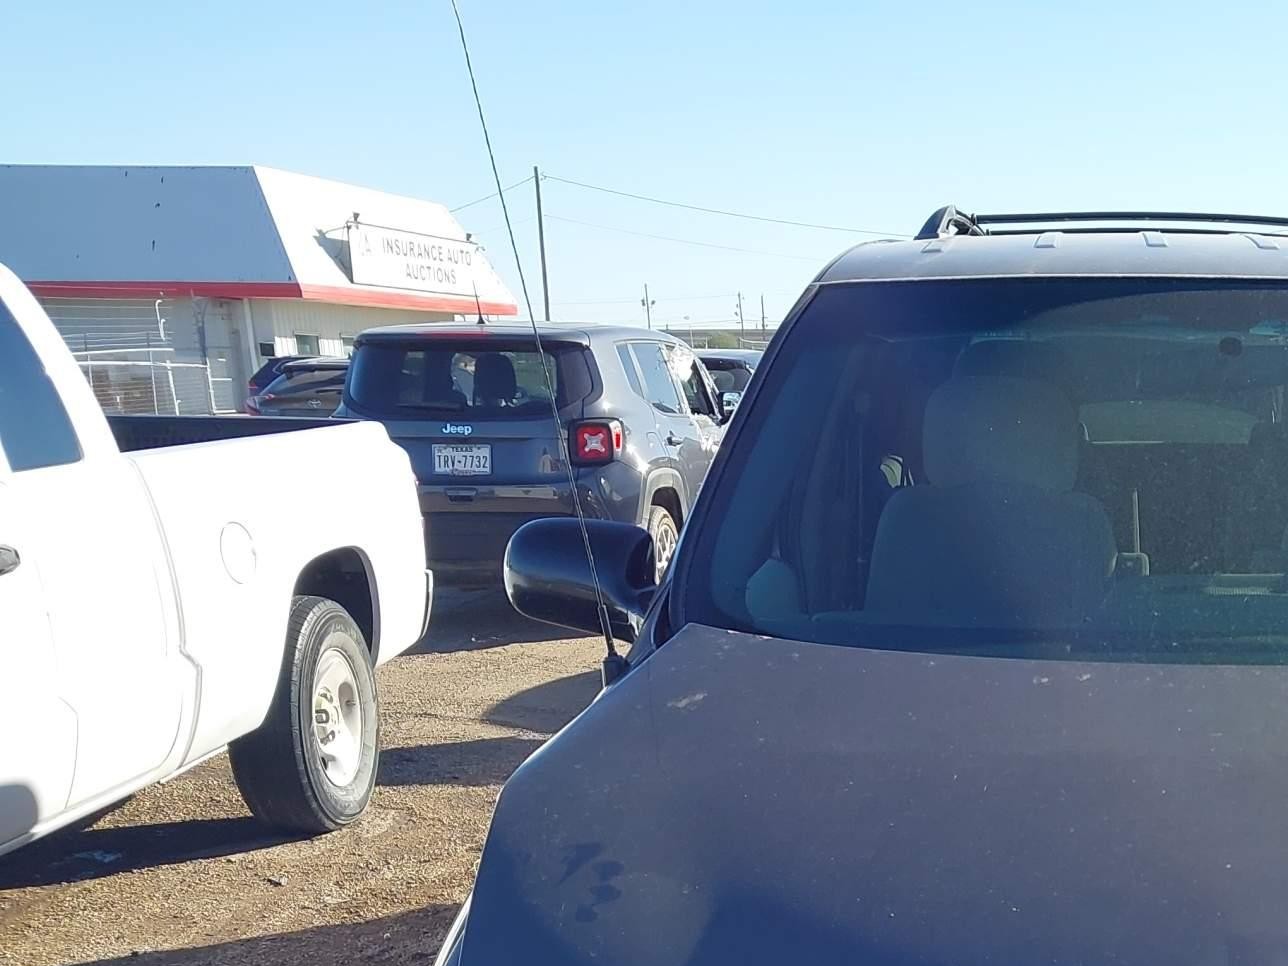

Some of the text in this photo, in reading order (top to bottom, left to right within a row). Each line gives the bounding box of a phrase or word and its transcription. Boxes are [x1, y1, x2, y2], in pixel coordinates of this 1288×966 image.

[382, 237, 444, 262] INSURANCE
[447, 247, 472, 266] AUTO
[405, 262, 457, 285] AUCTIONS
[442, 423, 472, 436] Jeep
